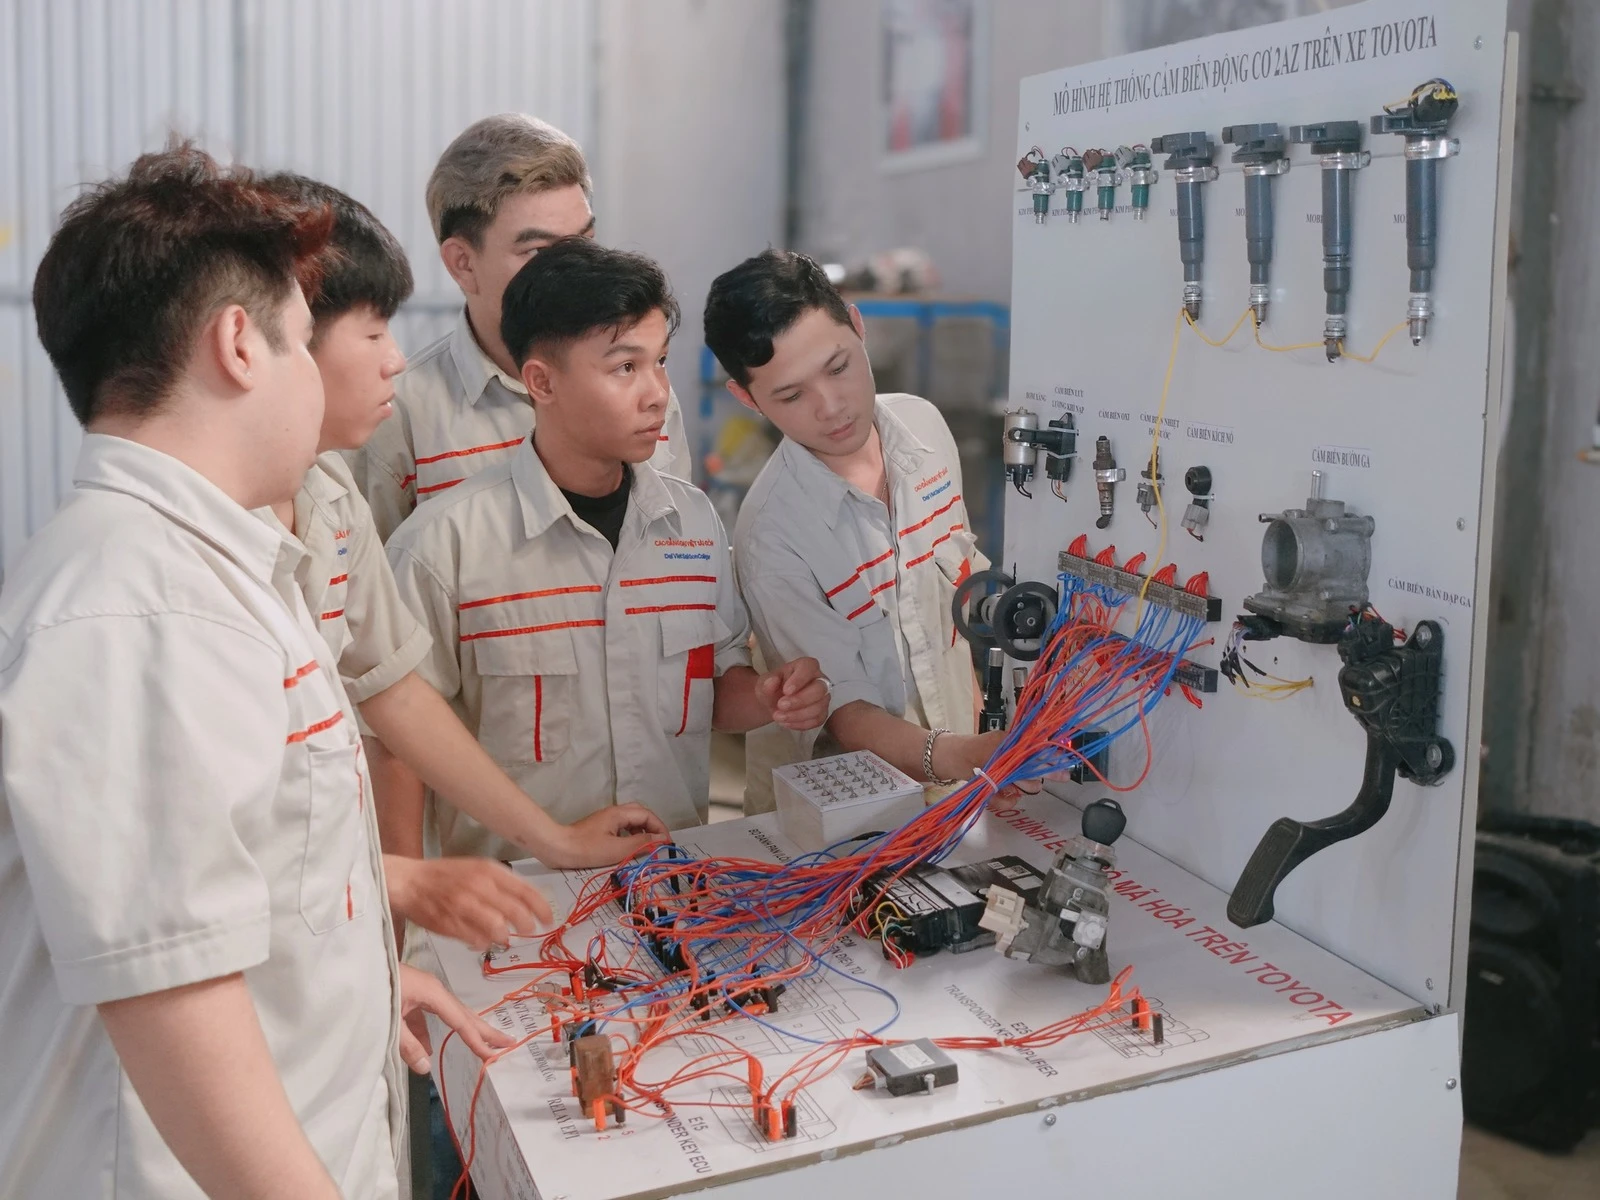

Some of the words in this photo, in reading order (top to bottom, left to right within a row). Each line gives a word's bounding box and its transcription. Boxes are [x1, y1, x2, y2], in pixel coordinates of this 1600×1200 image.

[1053, 82, 1069, 116] MÔ
[1072, 80, 1096, 113] HÌNH
[1098, 77, 1112, 113] HỆ
[1115, 69, 1150, 105] THỐNG
[1153, 62, 1179, 98] CẢM
[1182, 55, 1210, 93] BIẾN
[1212, 53, 1249, 93] ĐỘNG
[1252, 46, 1272, 80] CƠ
[1274, 43, 1300, 76] 2AZ
[1303, 26, 1343, 71] TRÊN
[1345, 29, 1367, 63] XE
[1371, 15, 1437, 58] TOYOTA
[1006, 816, 1060, 841] HÌNH
[1113, 879, 1159, 903] MÃ
[1138, 899, 1197, 929] HÓA
[1185, 925, 1259, 965] TRÊN
[1244, 962, 1353, 1026] TOYOTA
[944, 984, 1002, 1029] TRANSPONDER
[1012, 1045, 1059, 1078] MPLIFIER
[1011, 1021, 1033, 1035] E25
[547, 1097, 572, 1124] RELAY
[561, 1124, 580, 1140] EFI
[688, 1116, 709, 1131] E15
[678, 1138, 701, 1155] KEY
[689, 1155, 712, 1174] ECU
